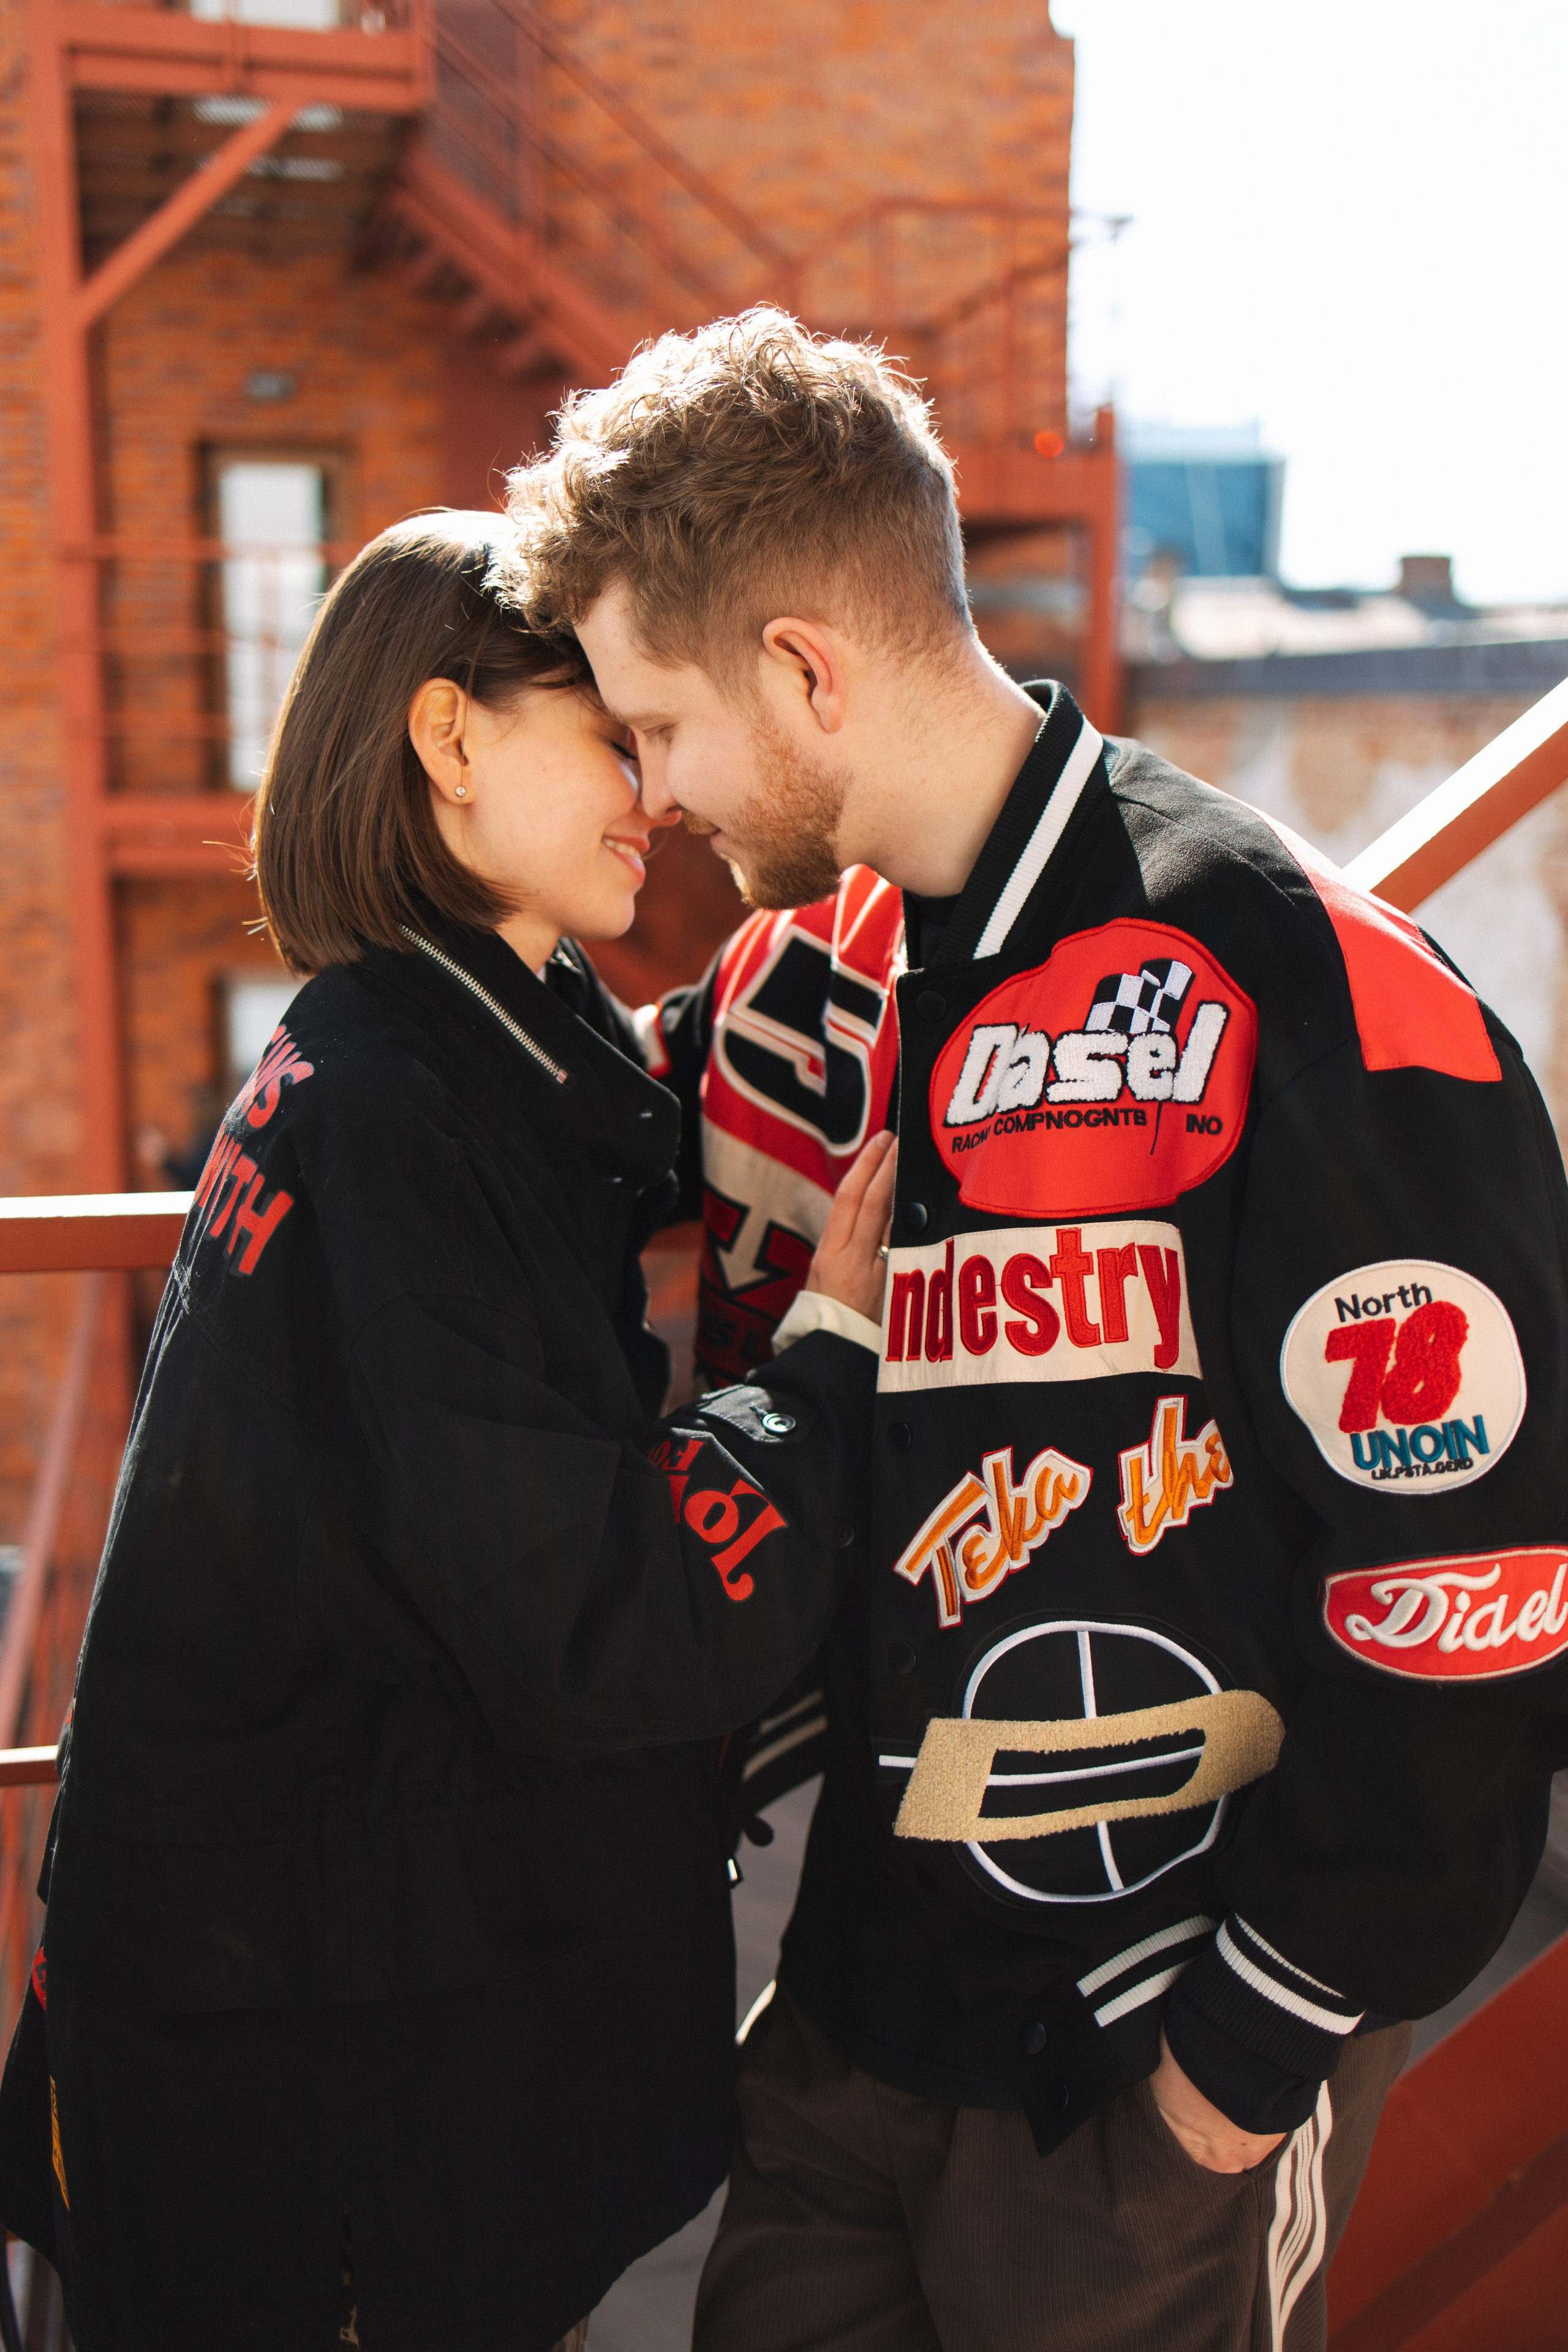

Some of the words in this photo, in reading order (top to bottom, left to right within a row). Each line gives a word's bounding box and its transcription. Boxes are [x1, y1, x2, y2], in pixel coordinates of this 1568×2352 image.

[1335, 1283, 1433, 1322] North
[1325, 1299, 1469, 1433] 78
[1350, 1415, 1490, 1471] UNOIN
